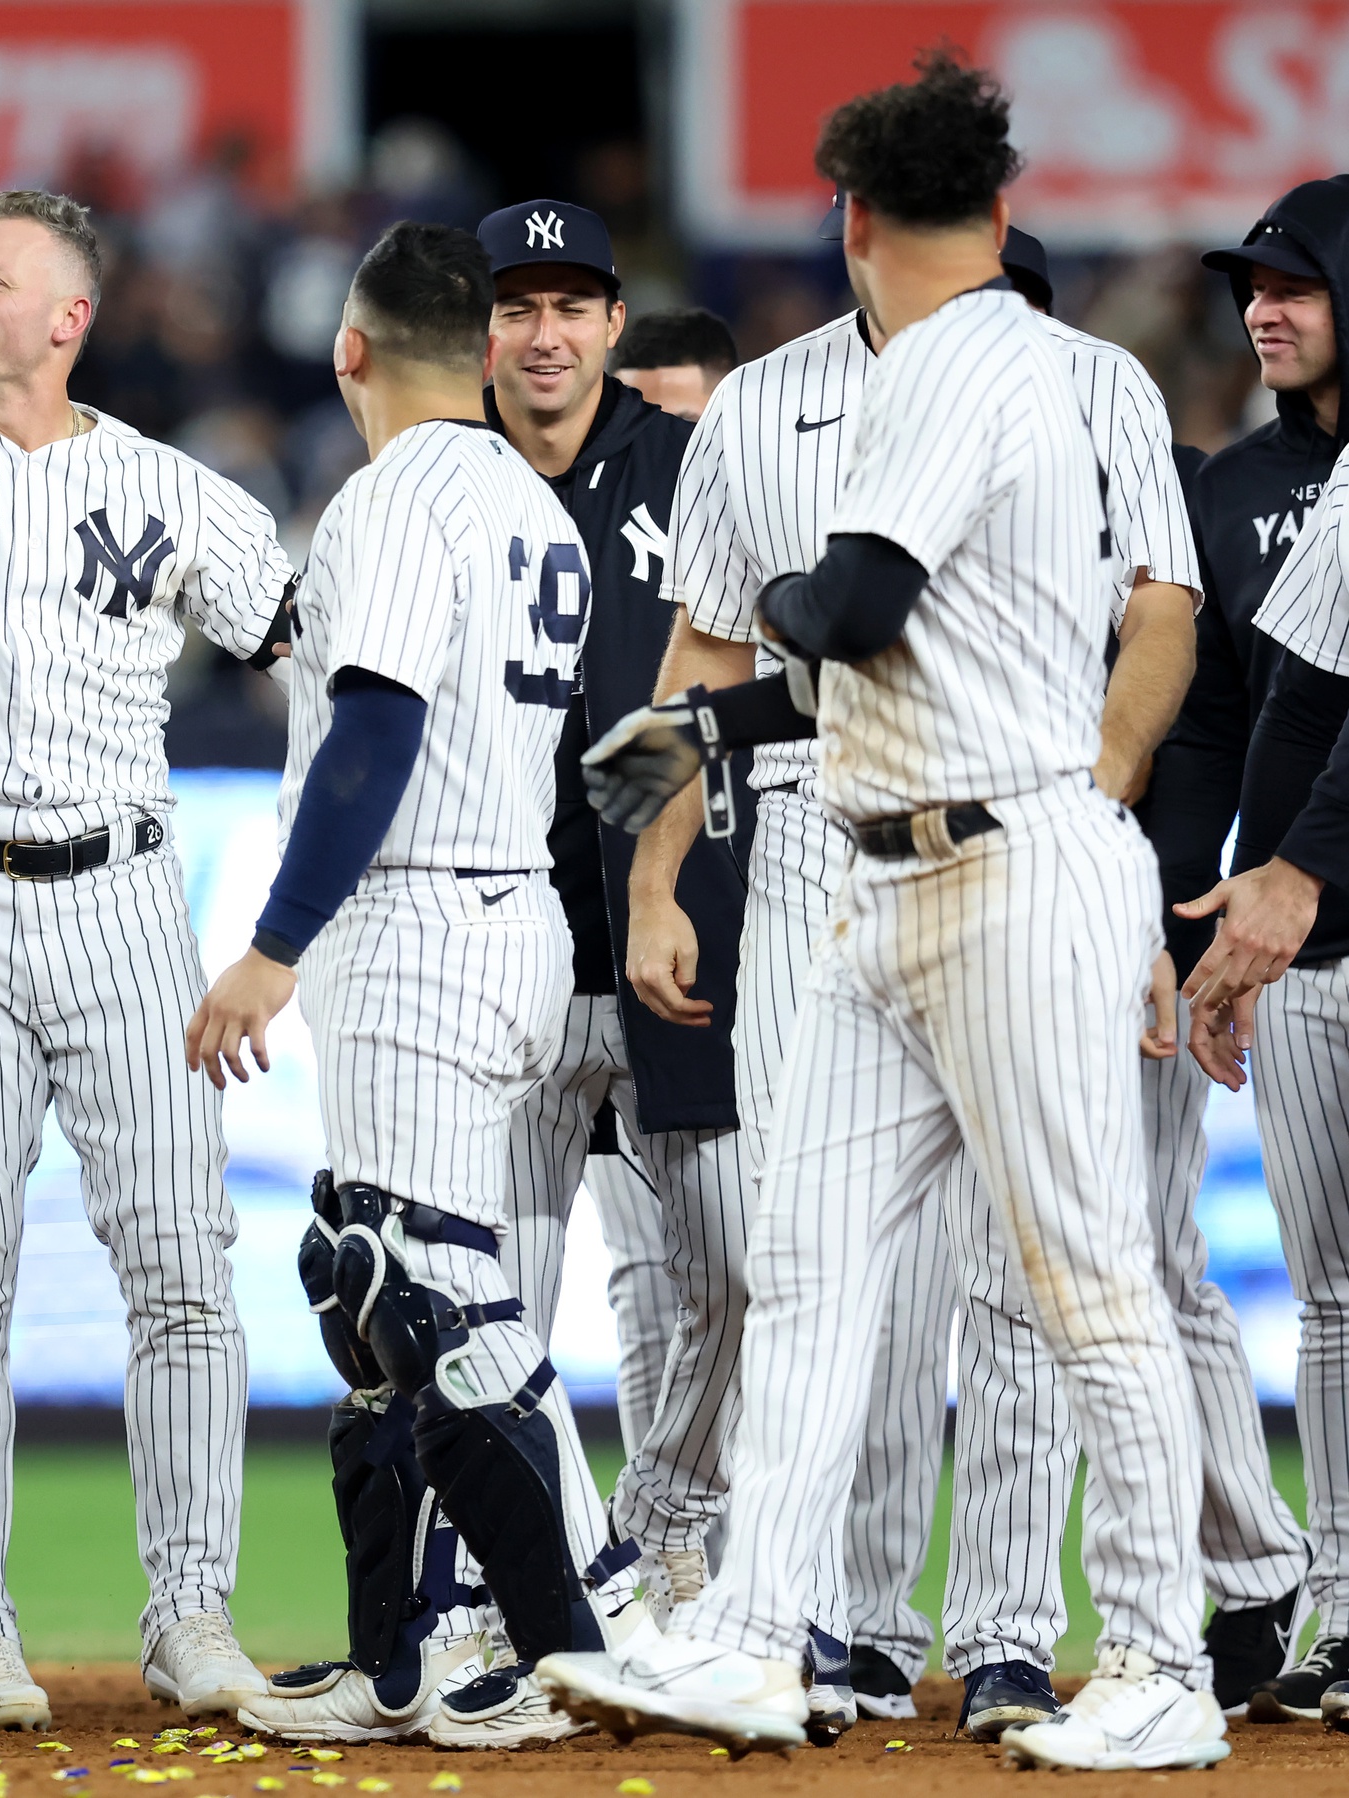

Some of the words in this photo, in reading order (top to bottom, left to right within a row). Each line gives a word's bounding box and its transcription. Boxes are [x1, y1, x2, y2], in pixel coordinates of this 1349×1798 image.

[525, 210, 566, 250] NY
[73, 507, 176, 619] NY
[146, 822, 162, 844] 28
